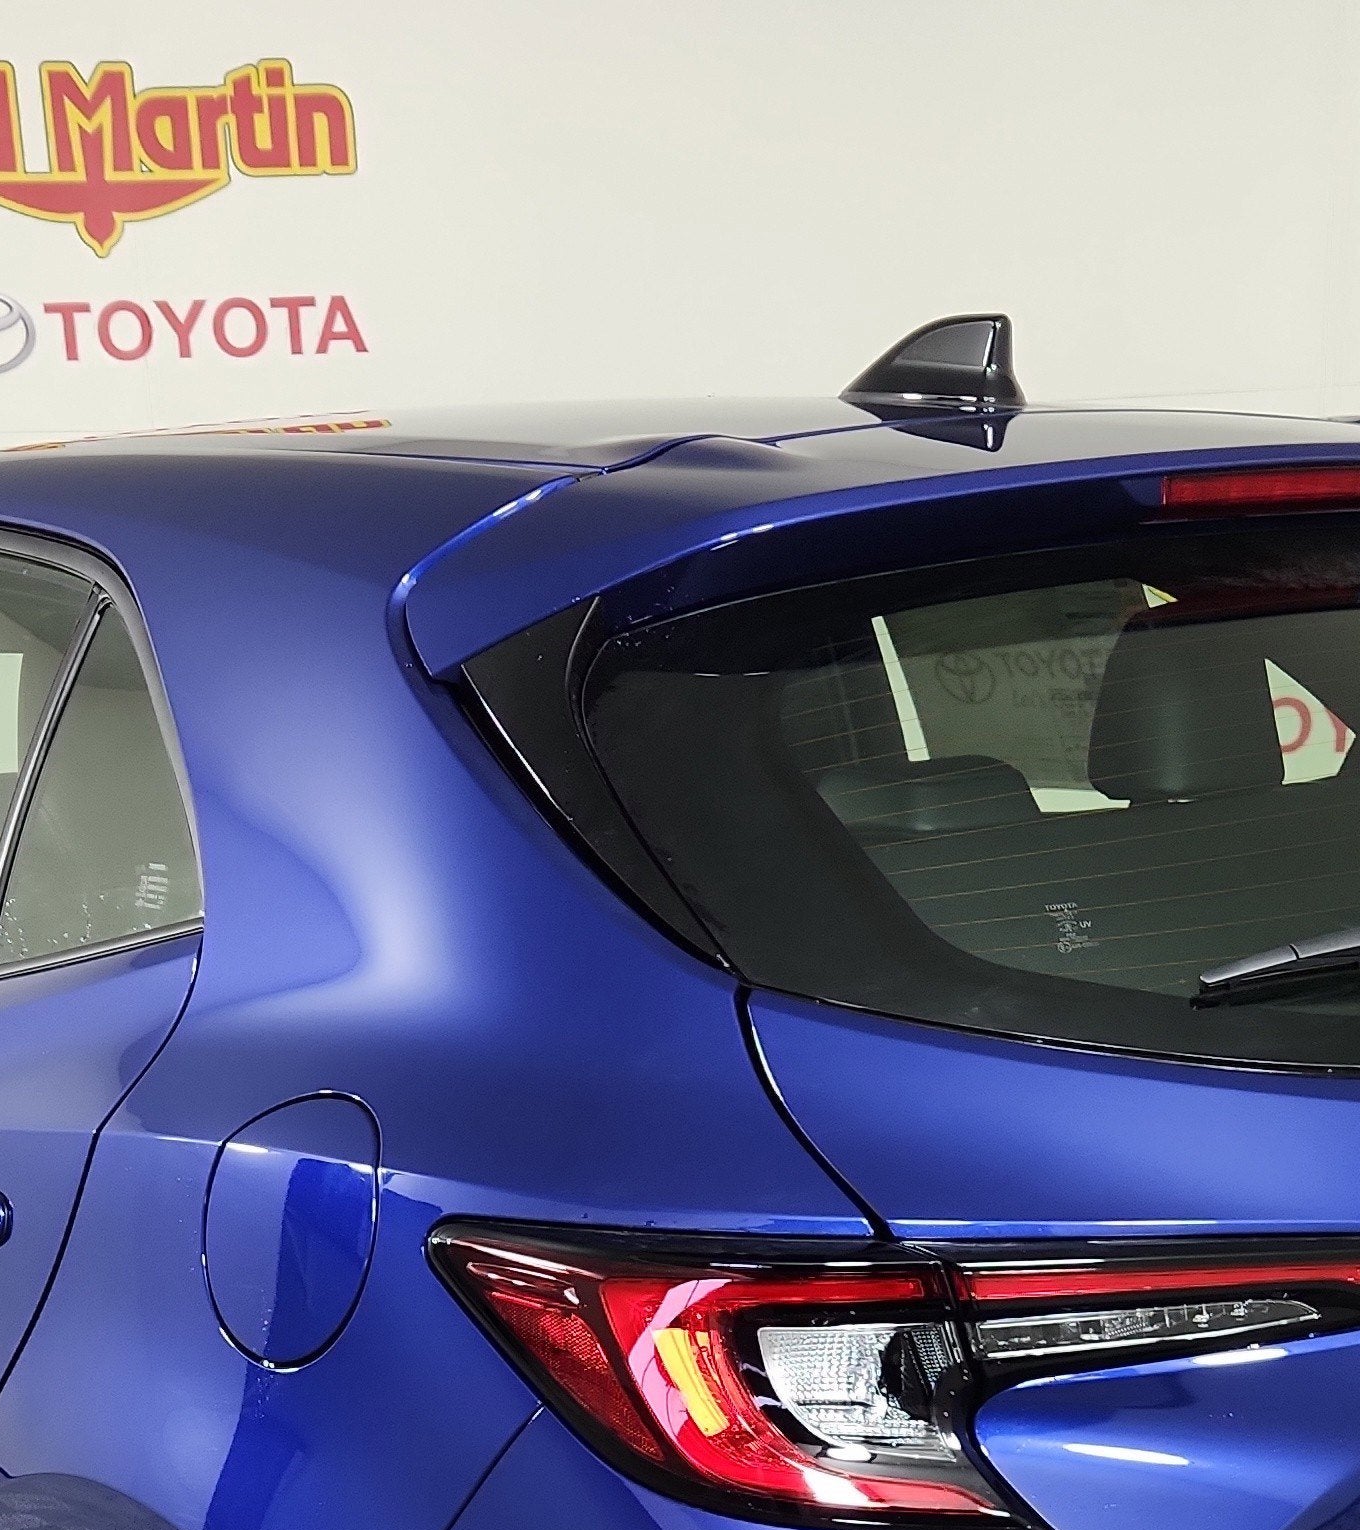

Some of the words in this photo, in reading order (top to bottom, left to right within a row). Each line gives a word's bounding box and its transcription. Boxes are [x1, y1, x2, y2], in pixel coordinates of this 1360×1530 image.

[42, 59, 356, 178] Martin
[44, 295, 368, 362] TOYOTA
[994, 648, 1103, 680] TOYOT
